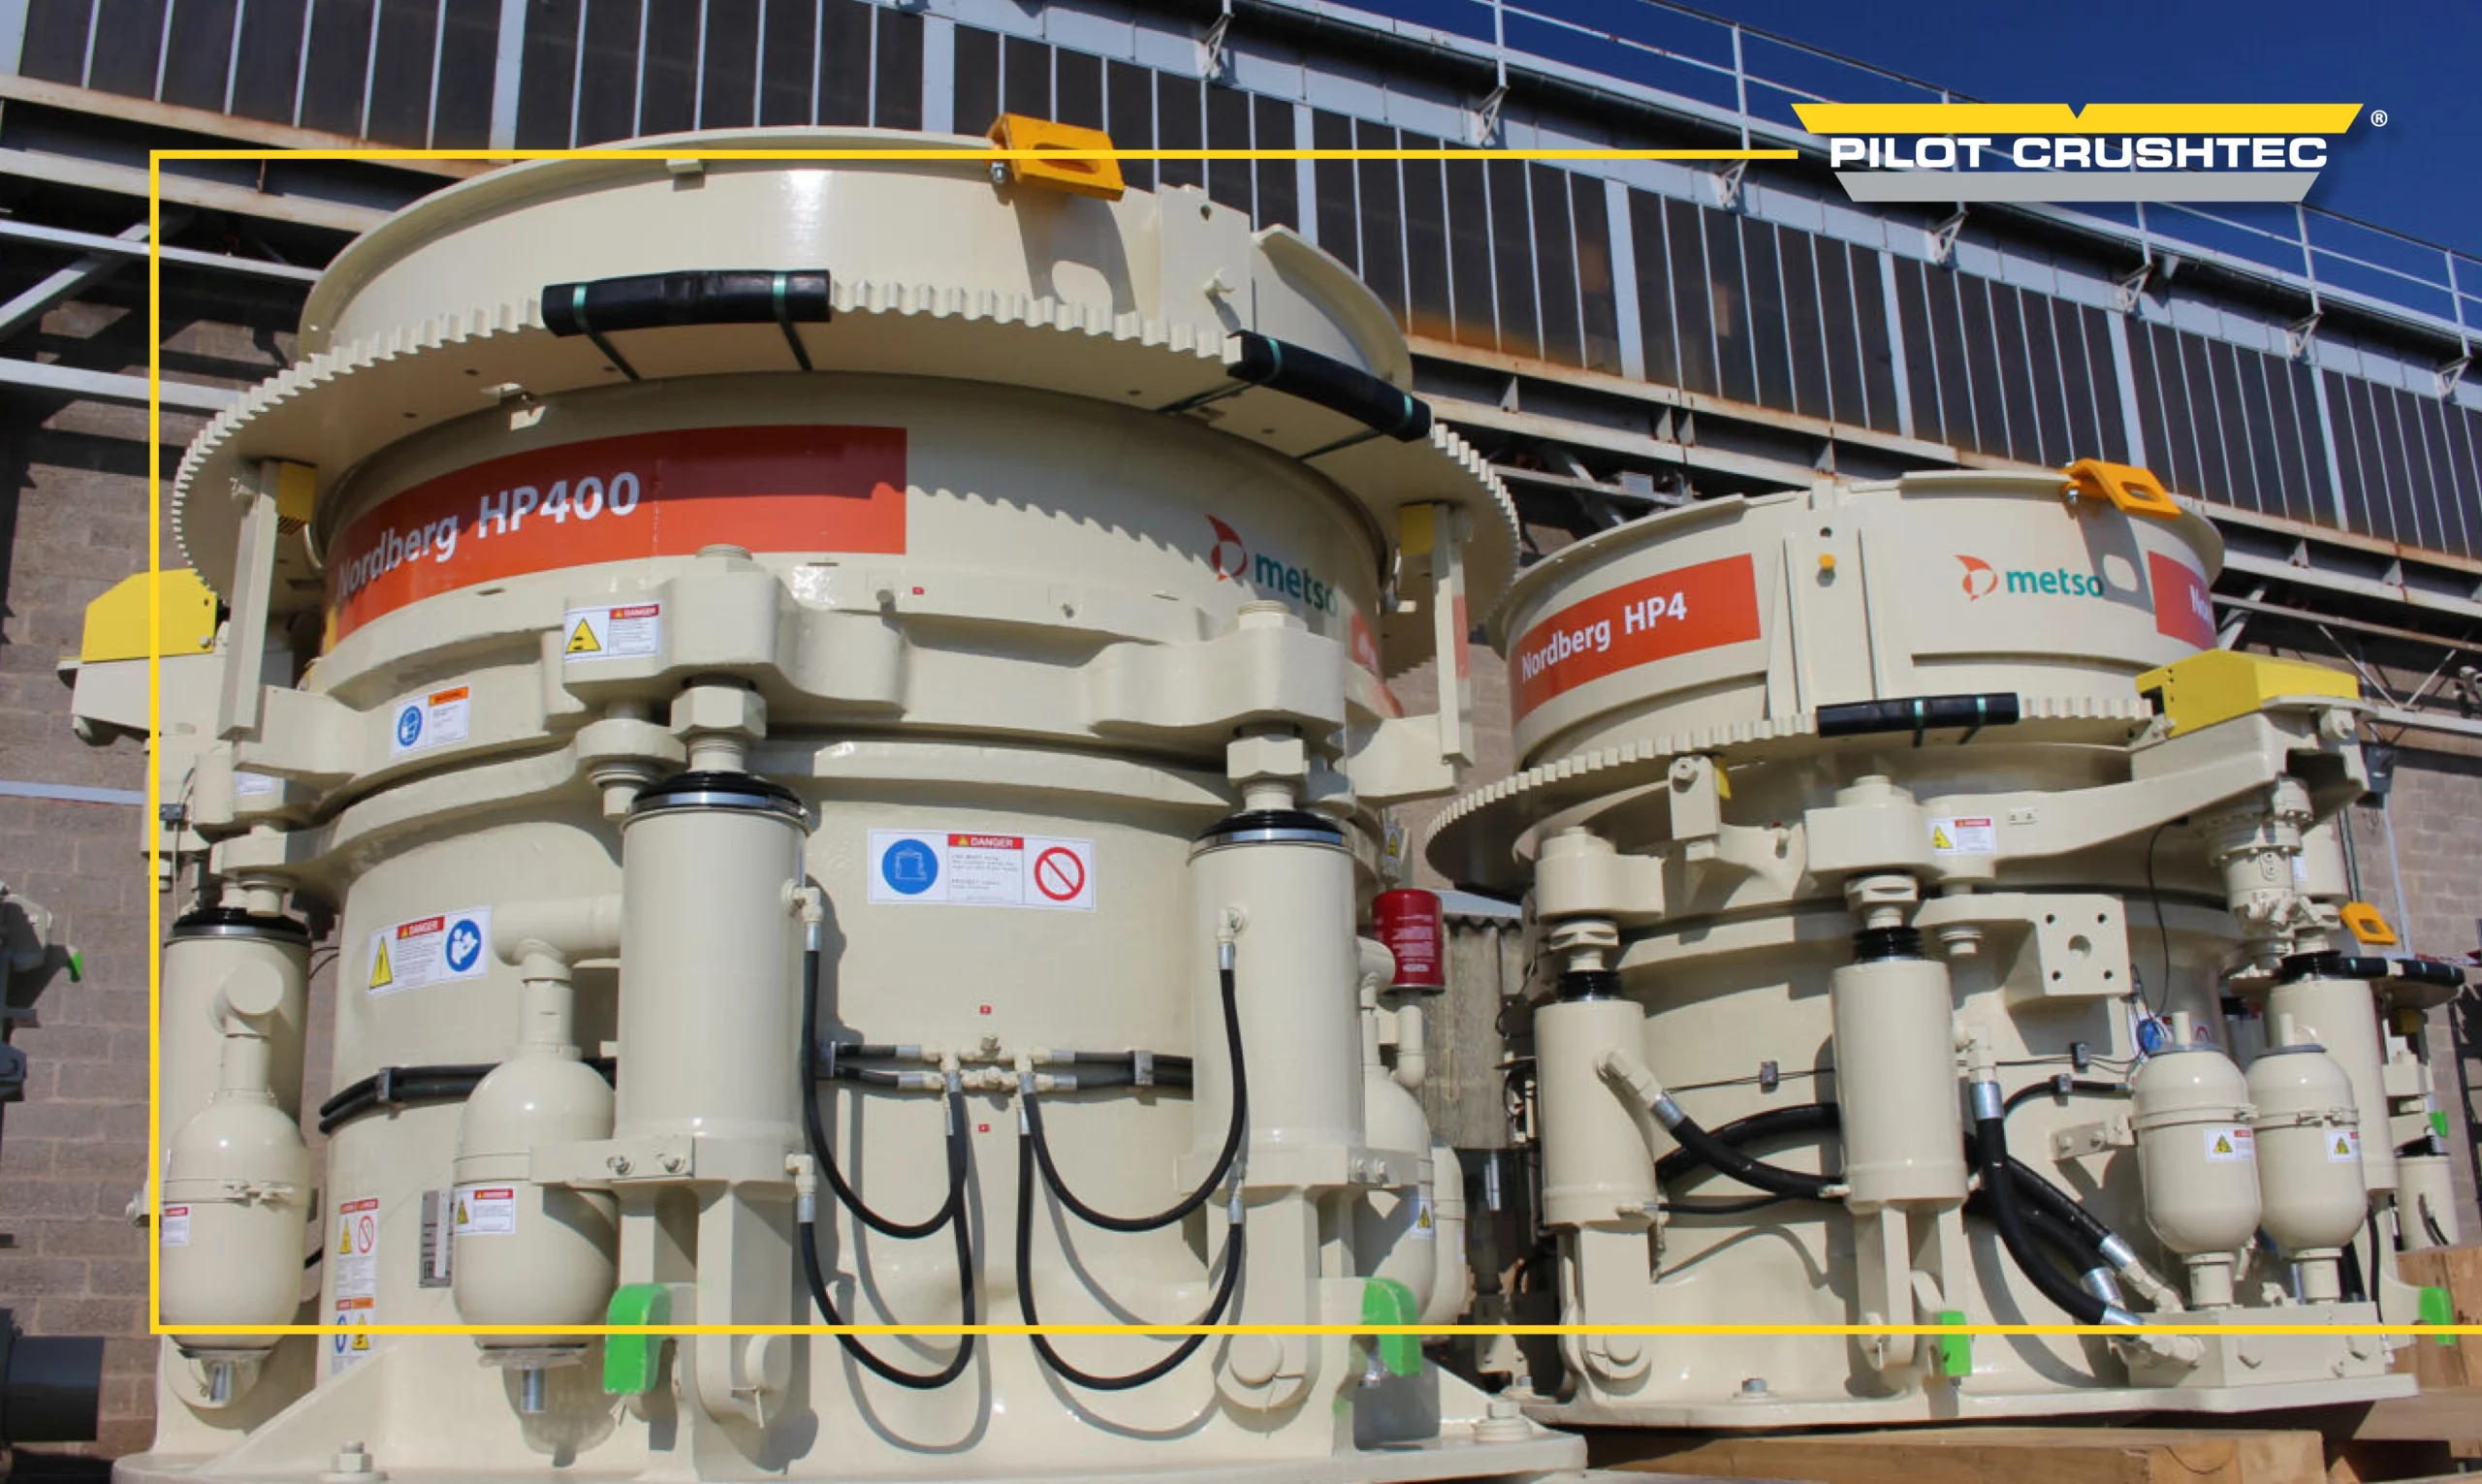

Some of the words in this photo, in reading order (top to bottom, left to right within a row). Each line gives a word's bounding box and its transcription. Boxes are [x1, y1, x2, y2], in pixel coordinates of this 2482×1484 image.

[337, 516, 458, 605] Nordberg
[478, 472, 640, 539] HP400
[1256, 553, 1338, 617] metso
[2006, 568, 2105, 597] metso
[1521, 618, 1611, 684] Nordberg
[1624, 592, 1688, 634] HP4
[971, 837, 1013, 847] DANGER
